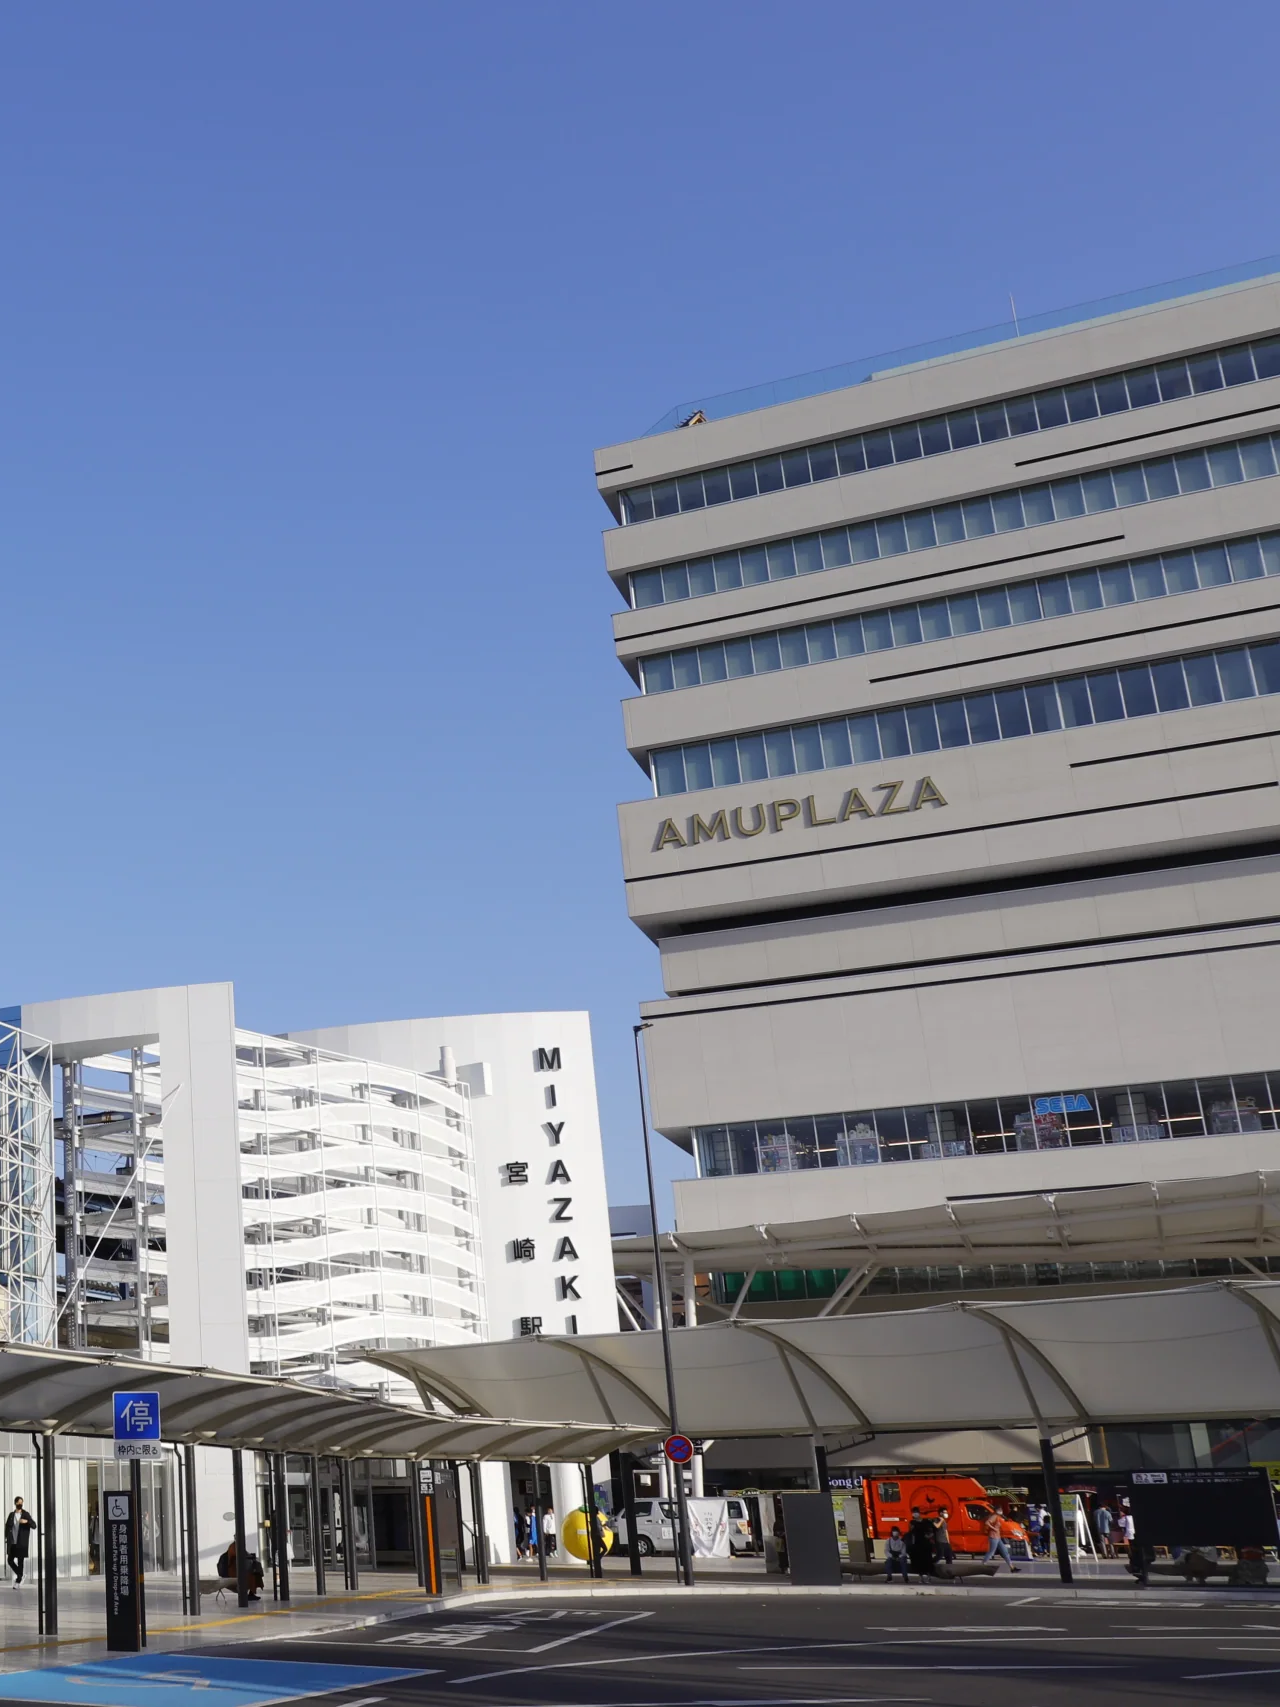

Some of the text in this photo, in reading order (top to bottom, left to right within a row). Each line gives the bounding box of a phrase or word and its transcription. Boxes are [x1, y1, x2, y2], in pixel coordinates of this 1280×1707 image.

[658, 776, 948, 850] AMUPLAZA
[1034, 1094, 1093, 1115] SEGA
[538, 1047, 582, 1335] MIYAZAKI
[506, 1161, 542, 1336] 宮崎駅
[121, 1400, 152, 1431] 停
[117, 1444, 158, 1455] 枠内に限る
